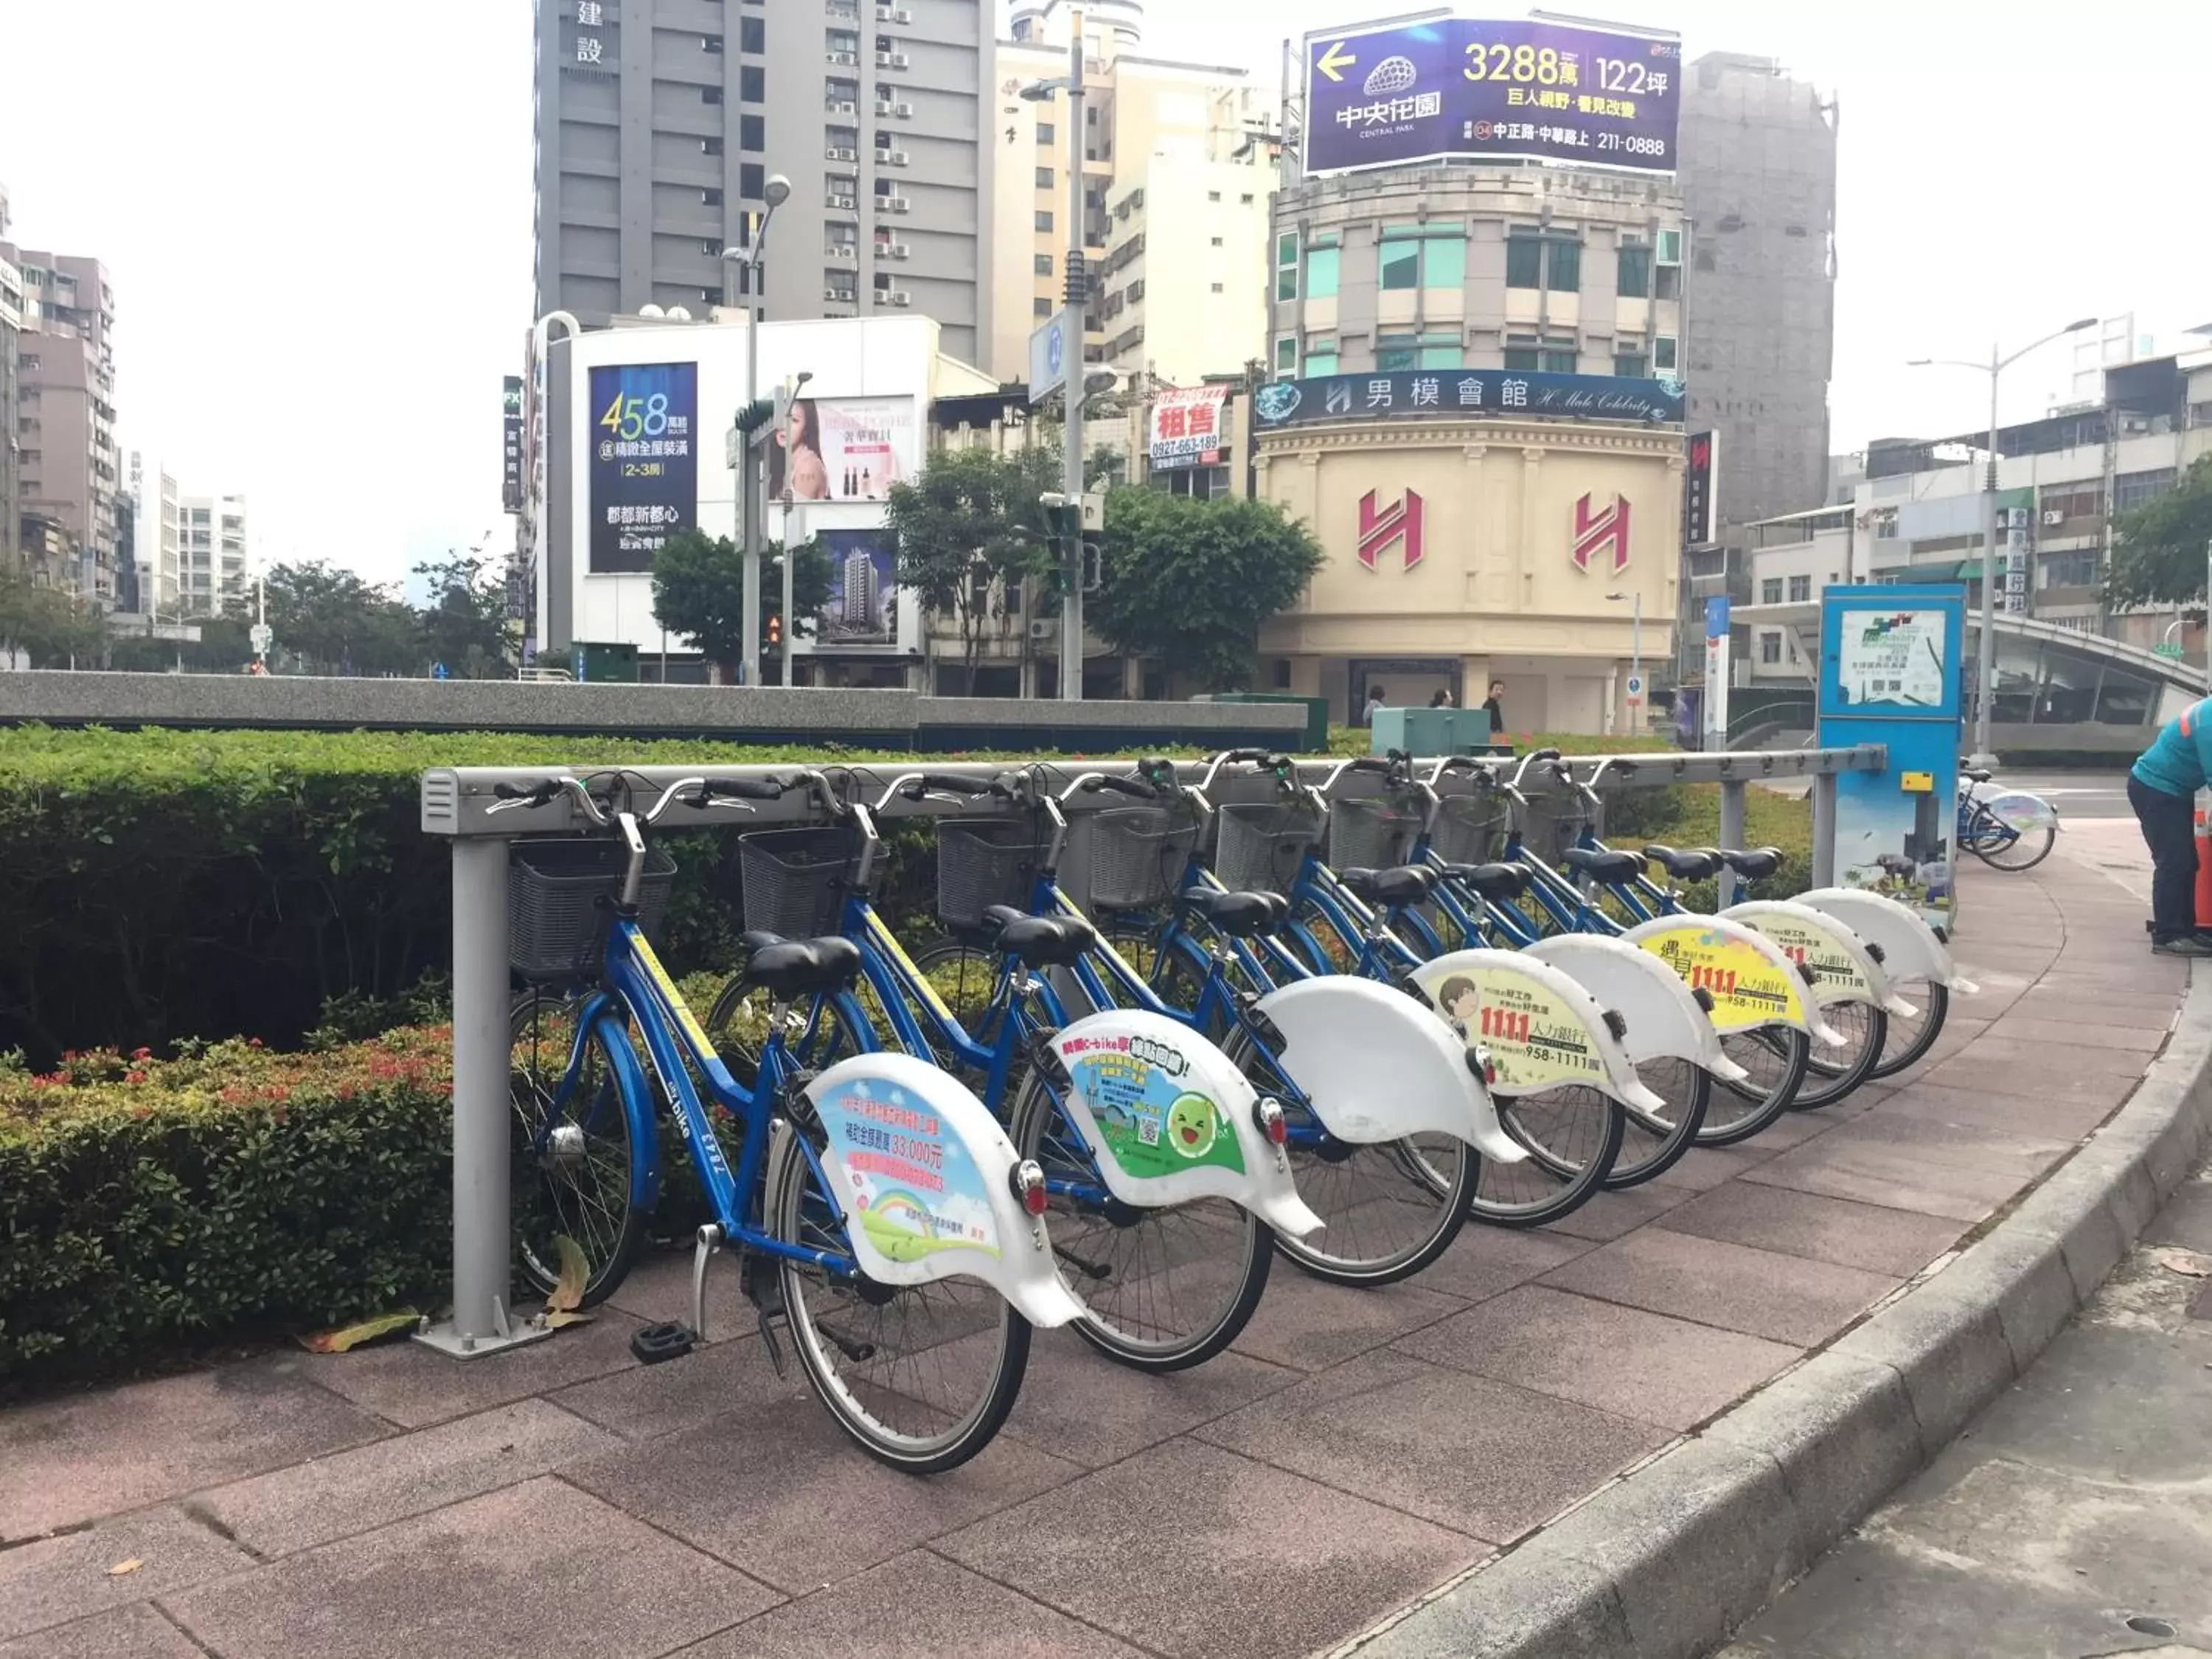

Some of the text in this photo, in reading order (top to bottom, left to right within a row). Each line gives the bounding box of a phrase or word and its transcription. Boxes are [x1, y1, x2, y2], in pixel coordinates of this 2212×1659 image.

[1596, 58, 1668, 97] 122坪
[1336, 91, 1441, 129] 中央花園
[1359, 124, 1415, 139] CENTRAL PARK
[1597, 133, 1665, 156] 211-0888
[1366, 377, 1528, 408] 男模會館
[1158, 403, 1215, 440] 租售
[1481, 1006, 1529, 1043] 1111
[1526, 1046, 1587, 1069] 958-1111
